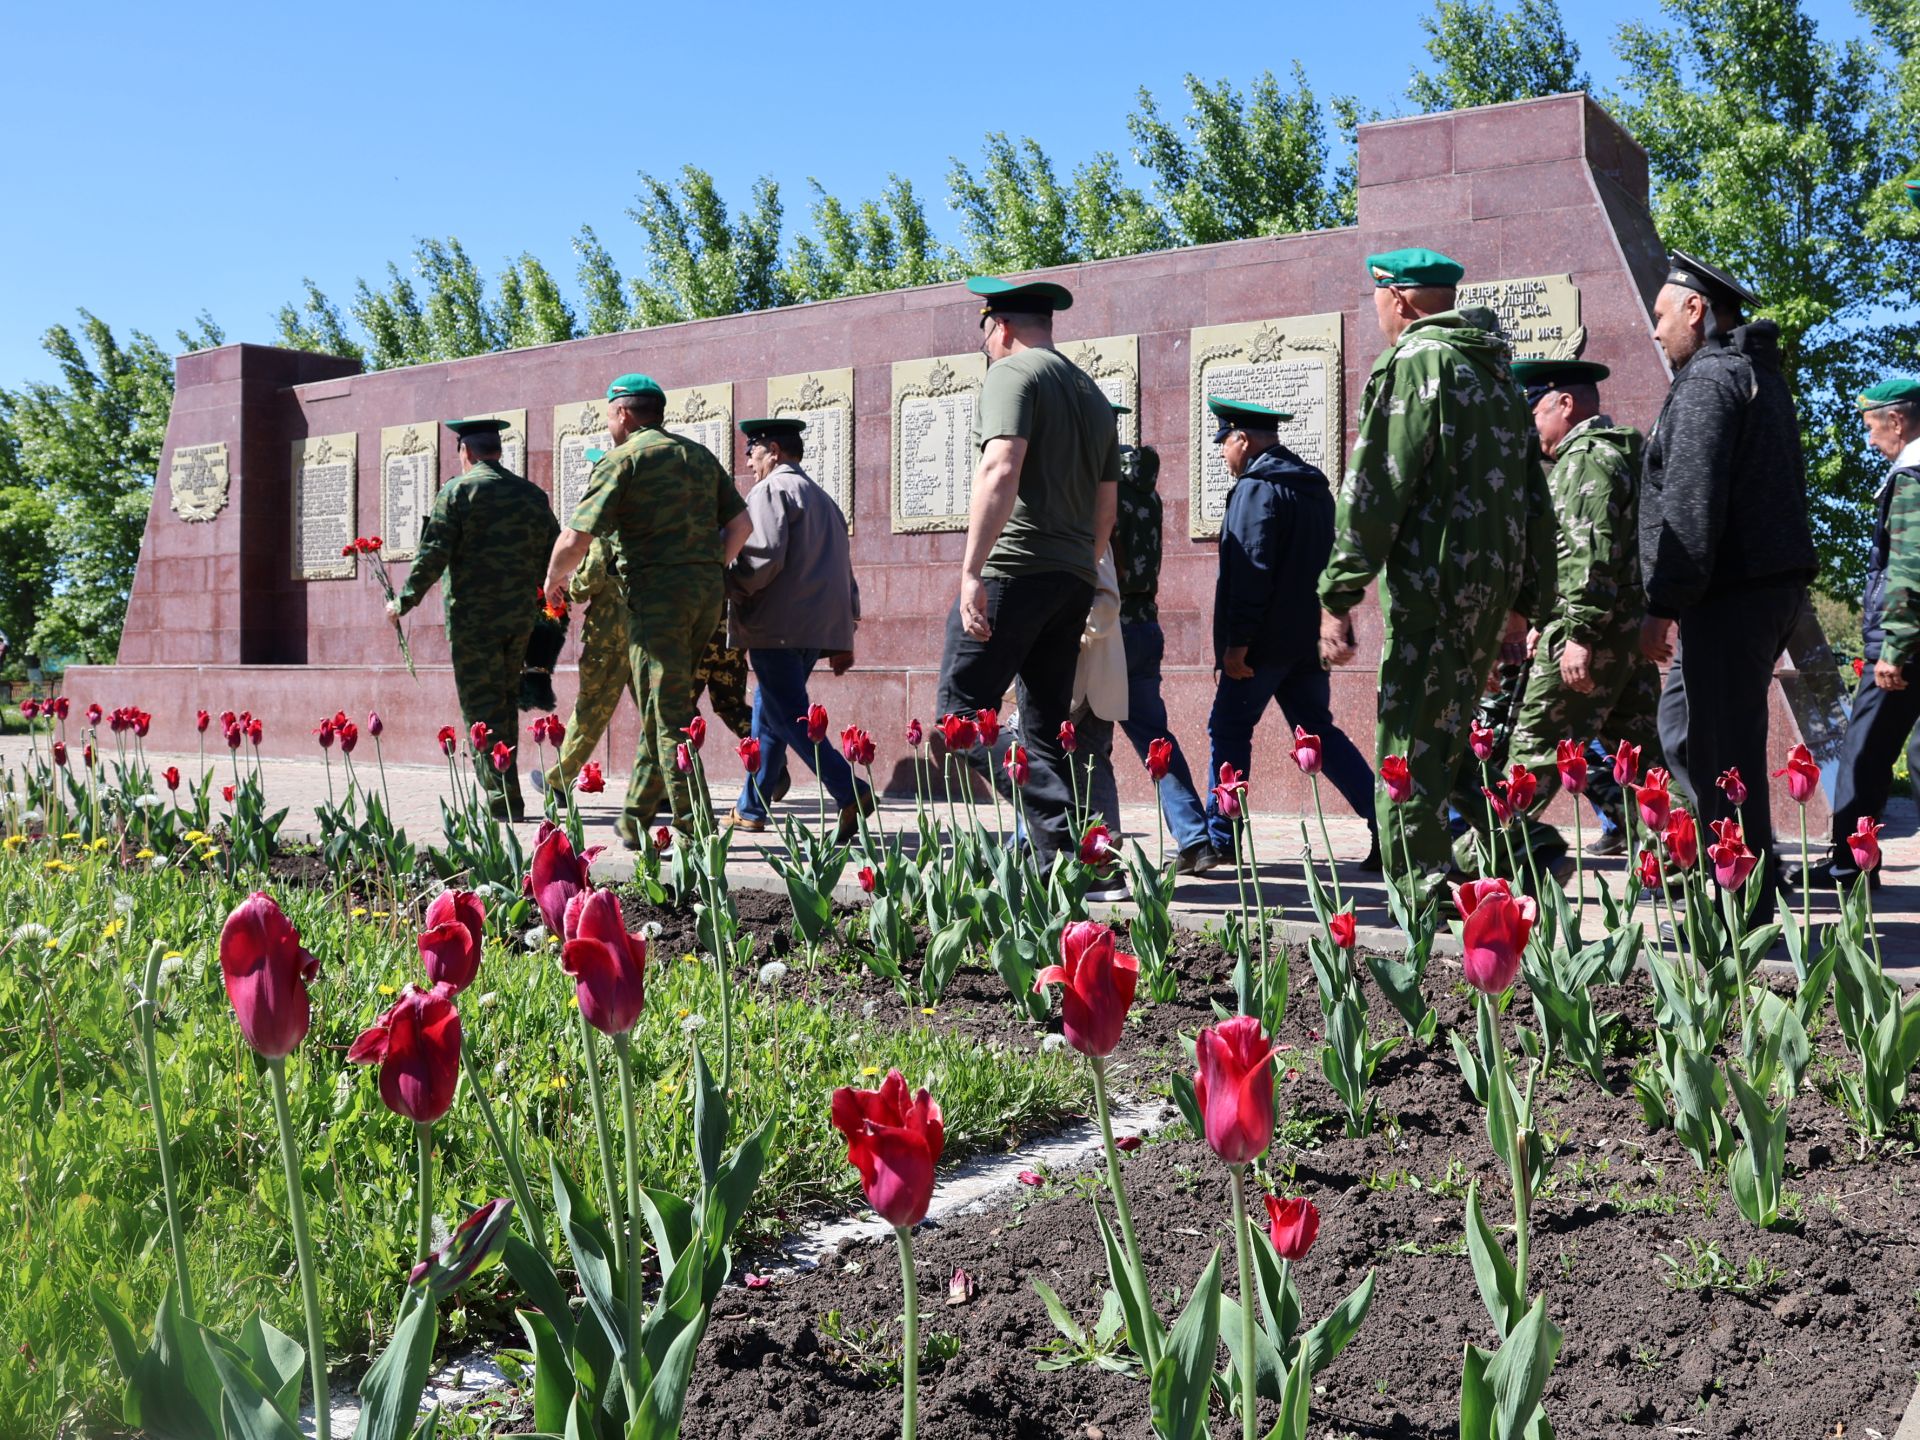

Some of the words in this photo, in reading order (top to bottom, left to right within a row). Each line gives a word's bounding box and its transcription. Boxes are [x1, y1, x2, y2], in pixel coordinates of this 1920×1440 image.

[1504, 280, 1546, 294] КАЛКА
[1520, 303, 1549, 316] БАСА
[1538, 326, 1561, 338] ИКЕ
